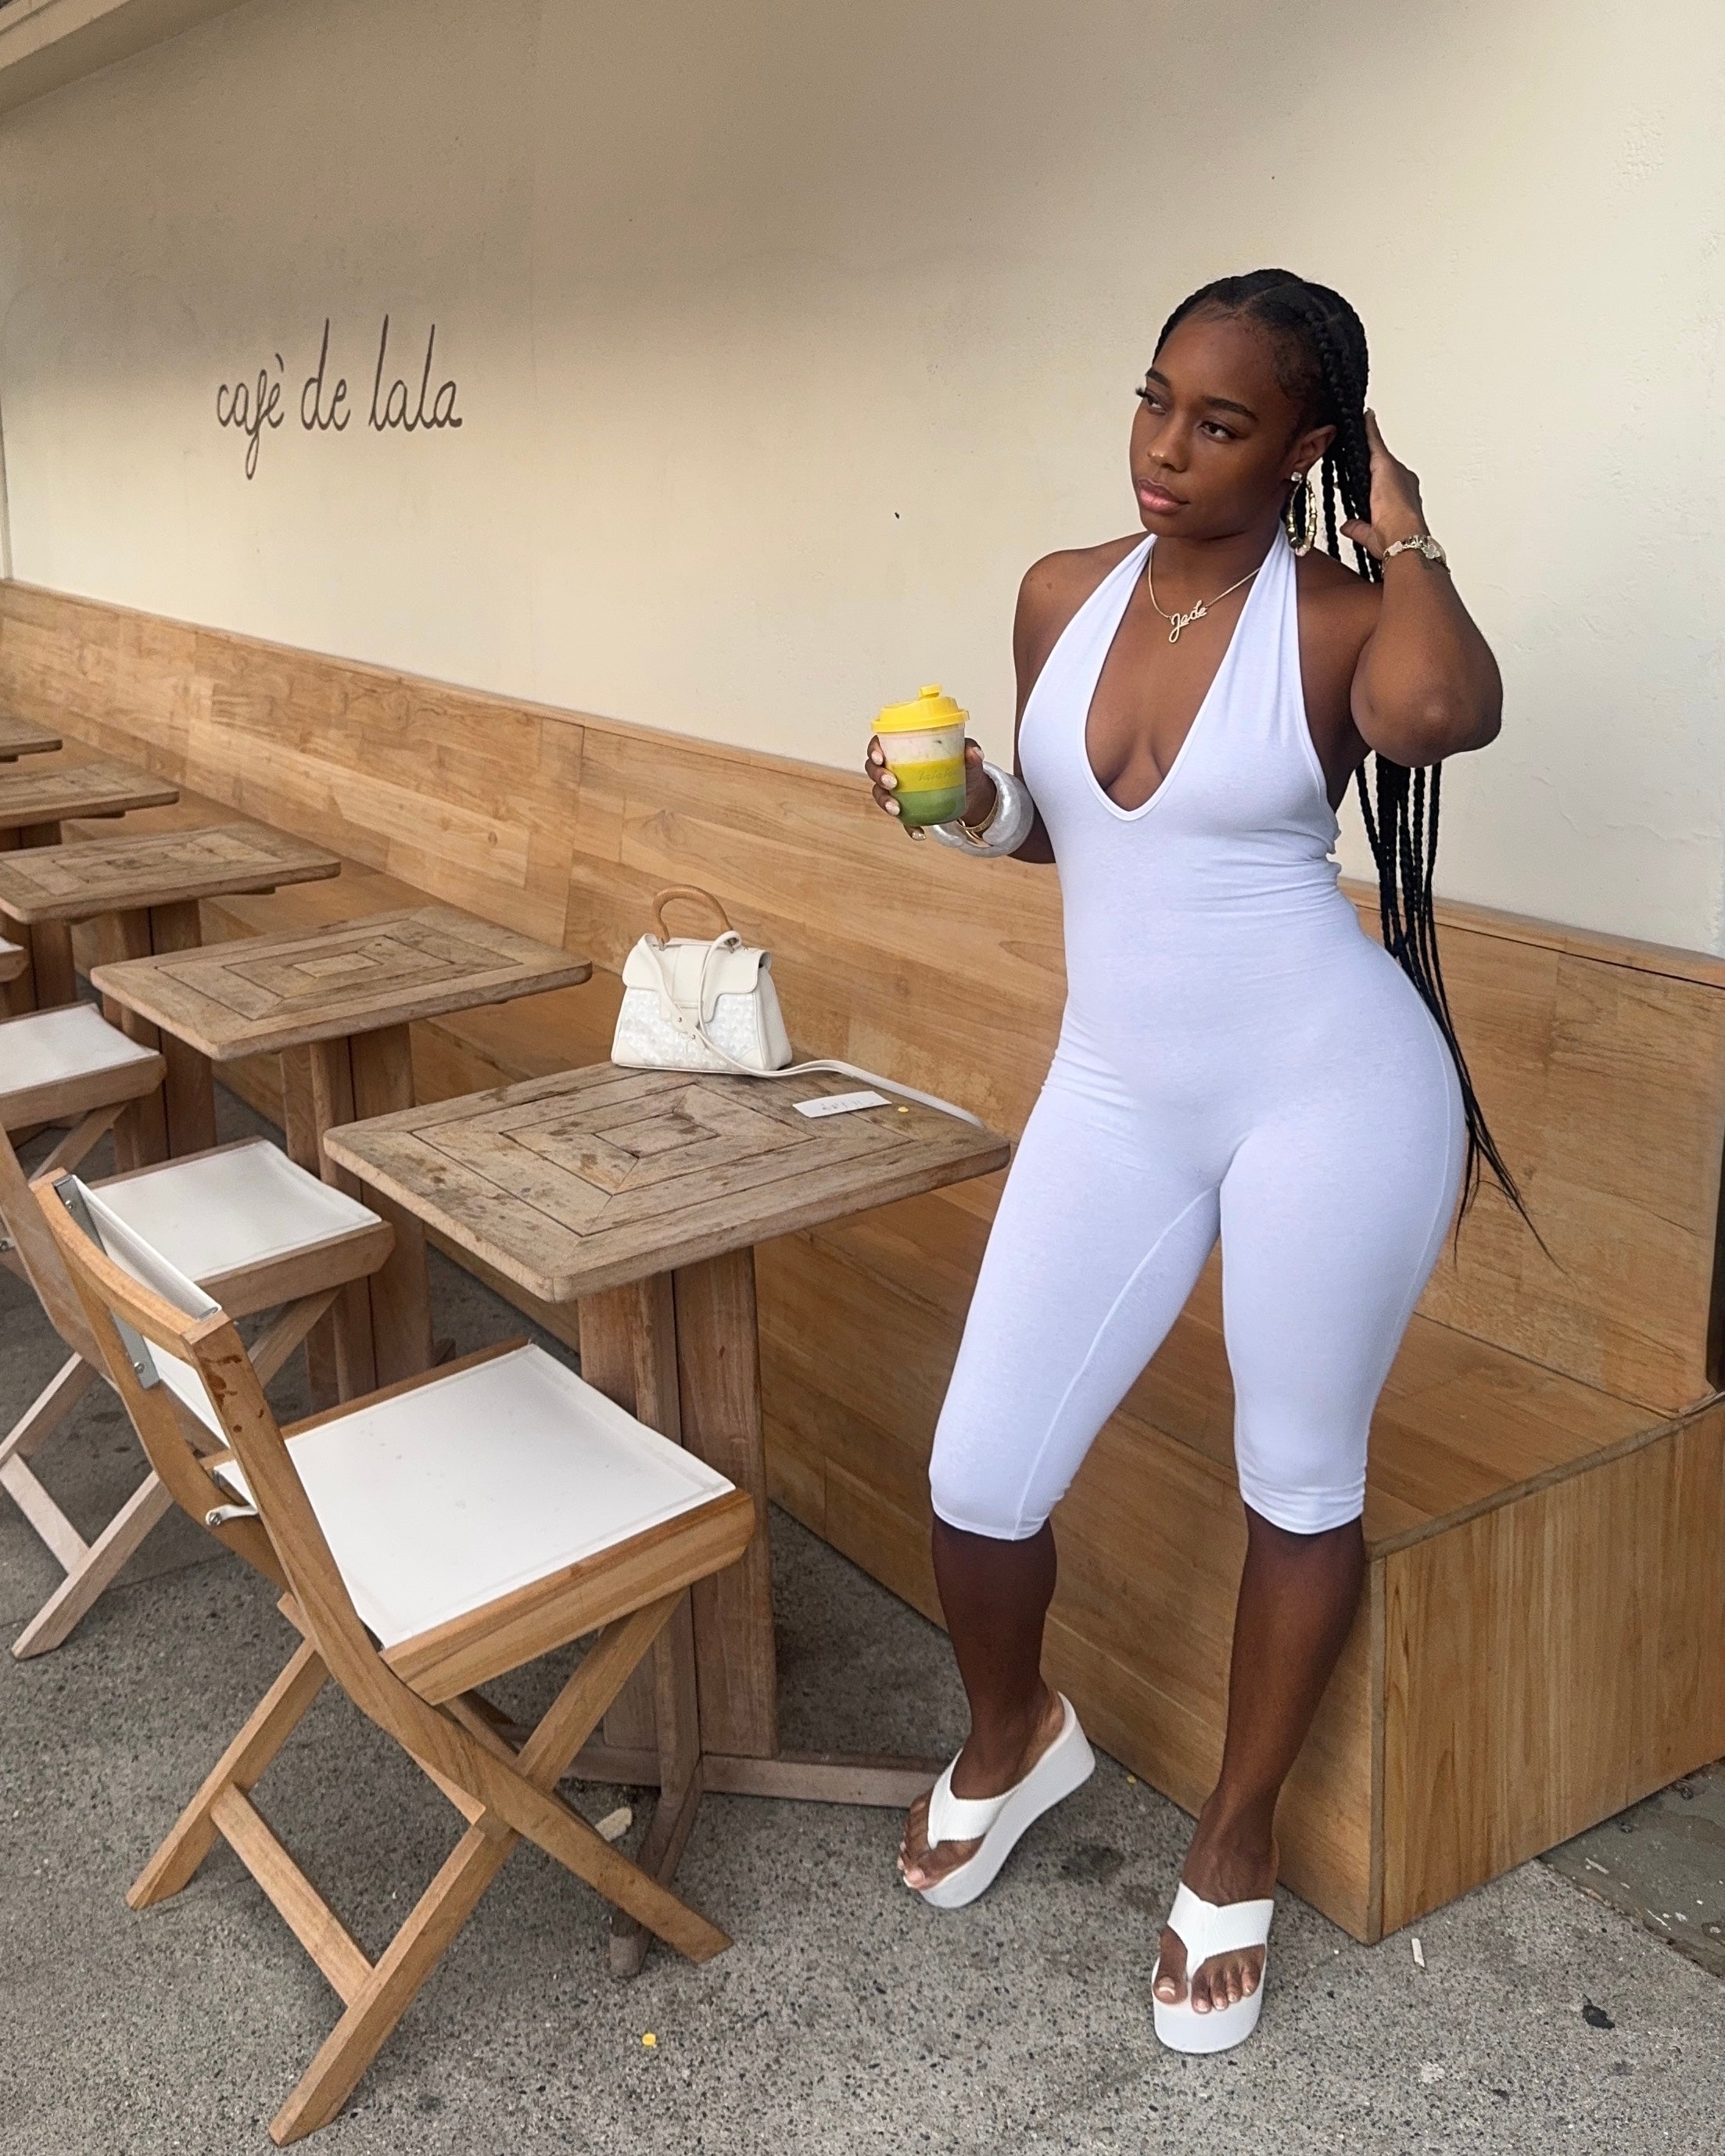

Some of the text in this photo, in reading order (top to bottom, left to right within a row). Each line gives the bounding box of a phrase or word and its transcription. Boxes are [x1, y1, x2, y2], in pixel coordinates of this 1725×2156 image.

[300, 317, 351, 431] de
[368, 314, 463, 432] lala
[1168, 600, 1208, 643] Jade
